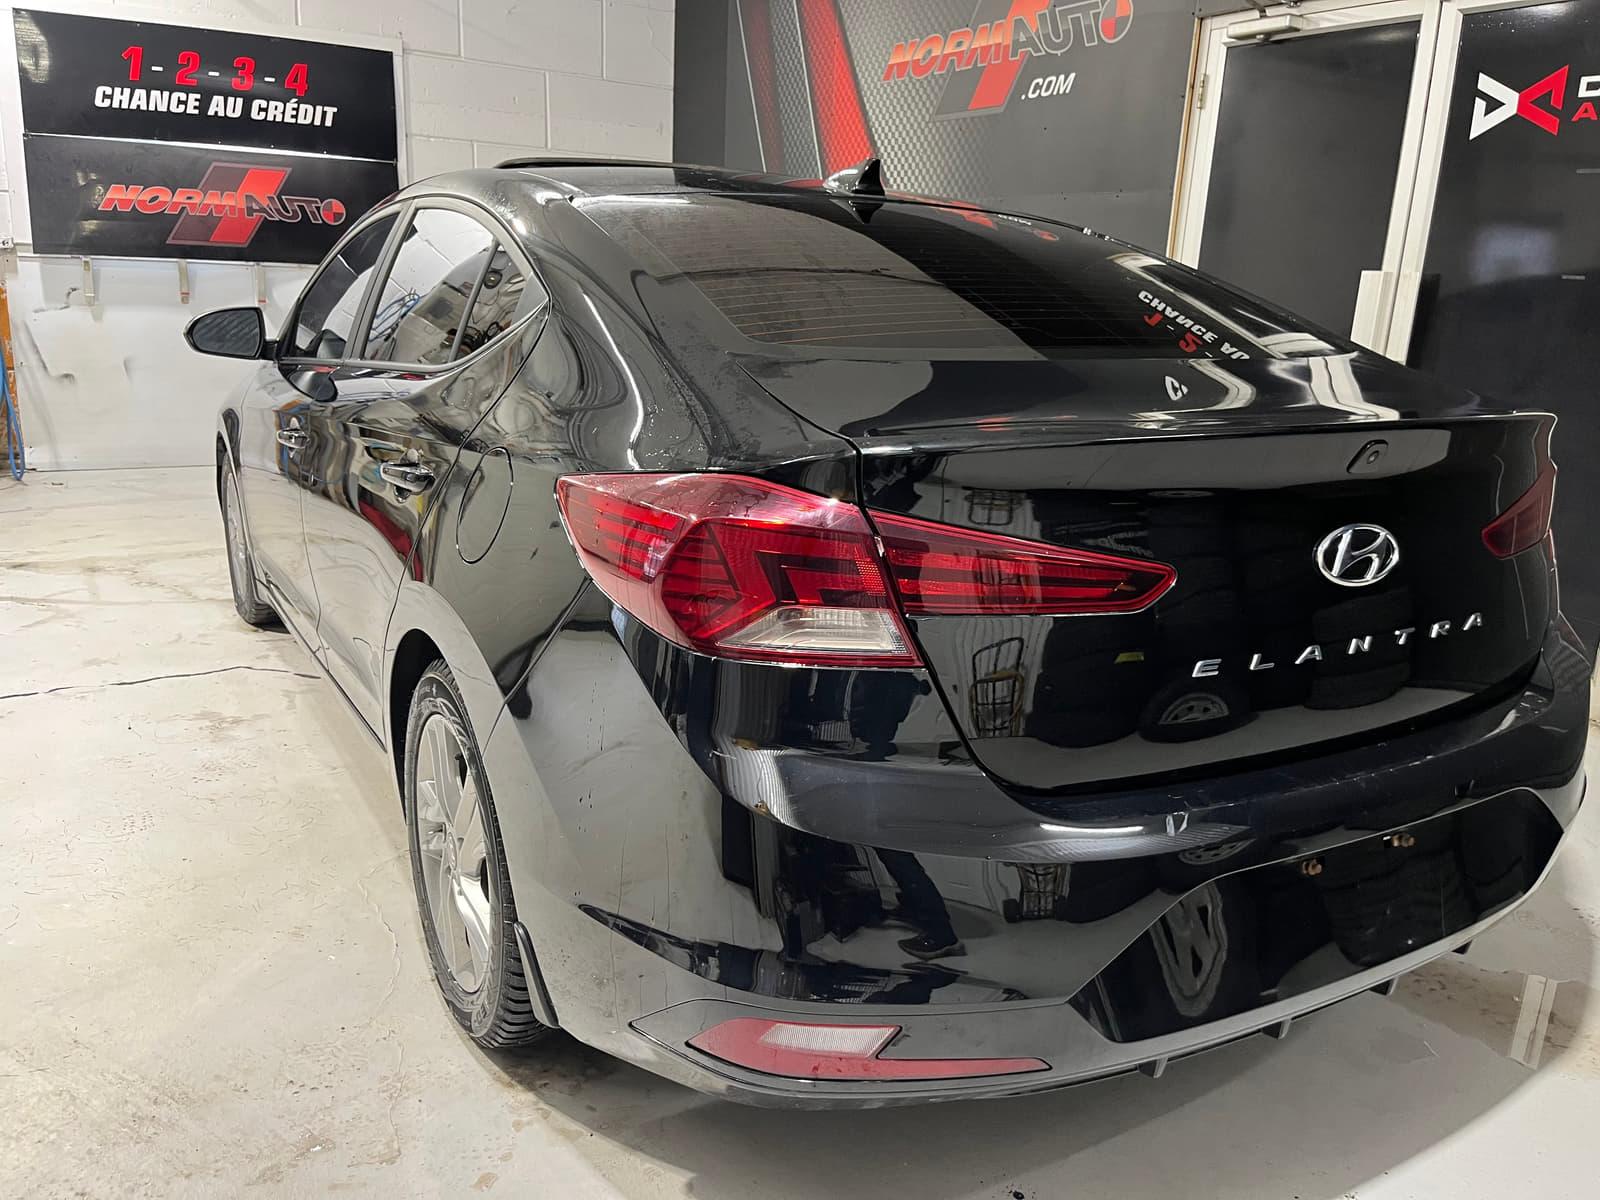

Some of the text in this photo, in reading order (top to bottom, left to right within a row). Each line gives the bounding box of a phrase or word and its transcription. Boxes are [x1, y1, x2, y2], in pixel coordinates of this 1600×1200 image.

[94, 86, 337, 127] CHANCE AU CRÉDIT
[1021, 72, 1076, 100] .COM
[98, 184, 346, 226] NORMAUTO
[1192, 611, 1483, 678] ELANTRA
